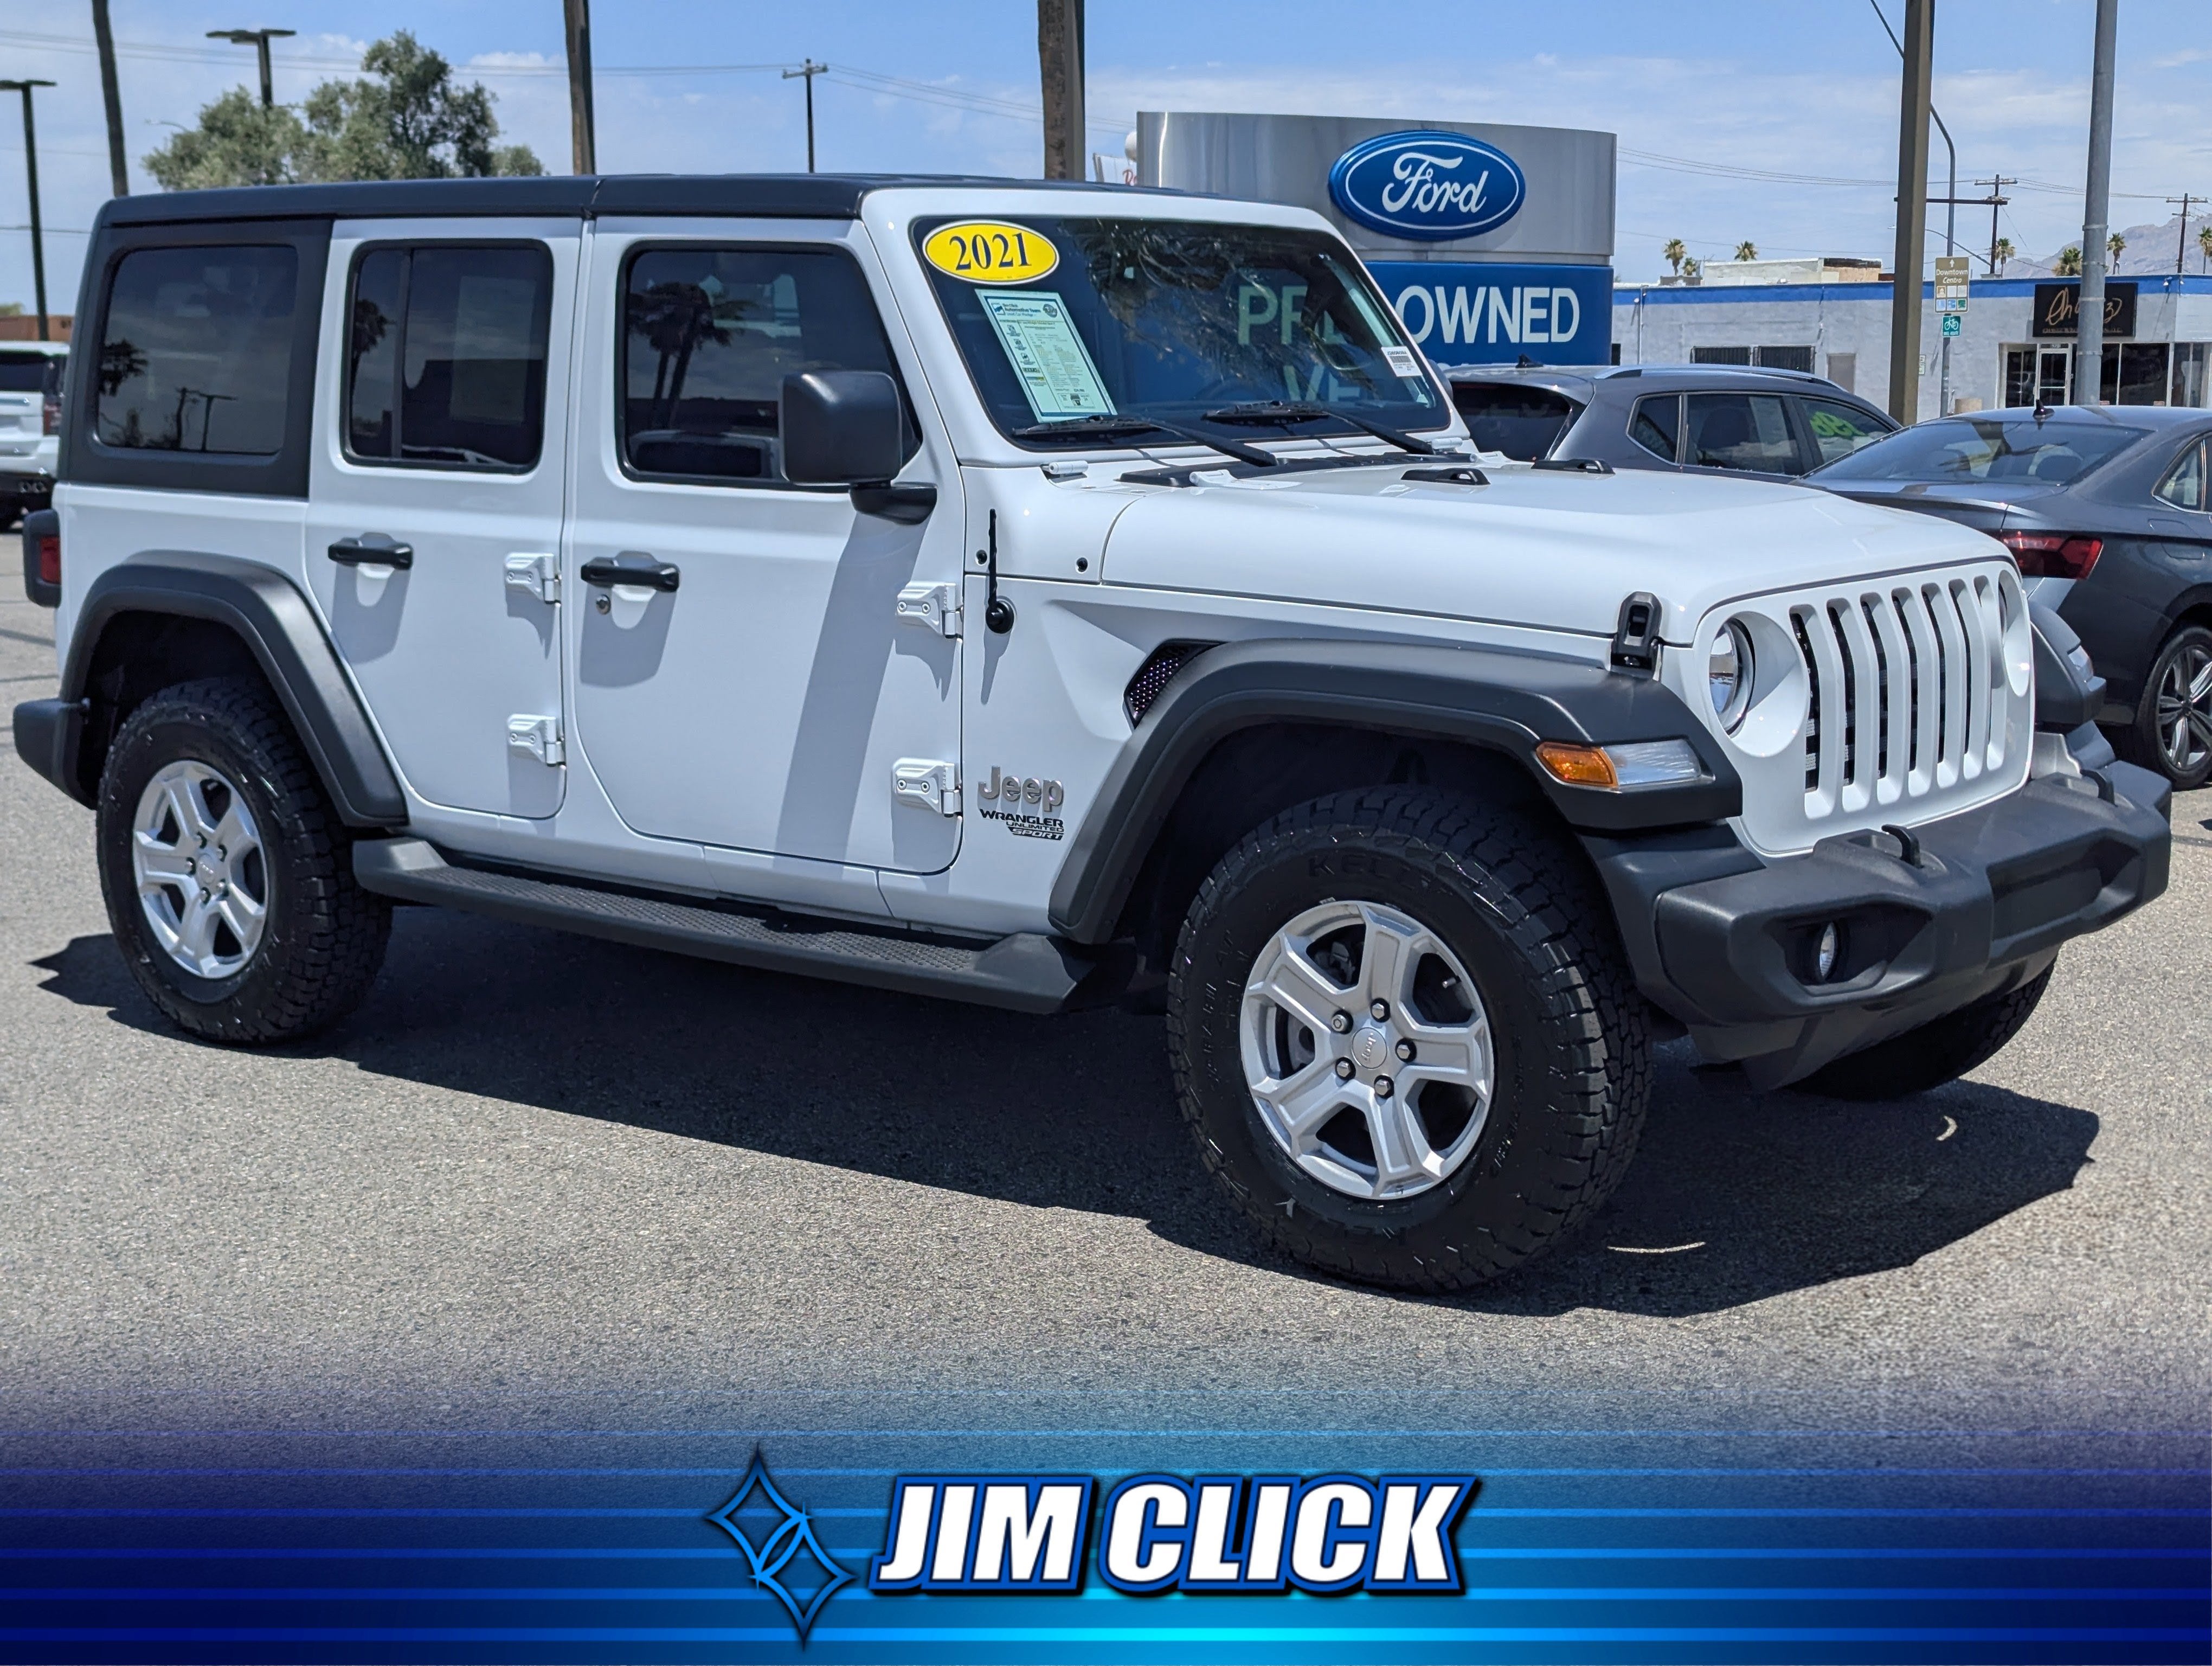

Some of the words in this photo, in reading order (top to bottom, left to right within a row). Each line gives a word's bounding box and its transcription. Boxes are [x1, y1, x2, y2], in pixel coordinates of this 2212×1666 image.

[1382, 152, 1489, 214] Ford
[949, 232, 1032, 271] 2021
[1396, 285, 1580, 344] OWNED
[978, 764, 1064, 812] Jeep
[980, 809, 1064, 828] WRANGLER
[1006, 821, 1064, 832] UNLIMITED
[1013, 828, 1063, 841] SPORT
